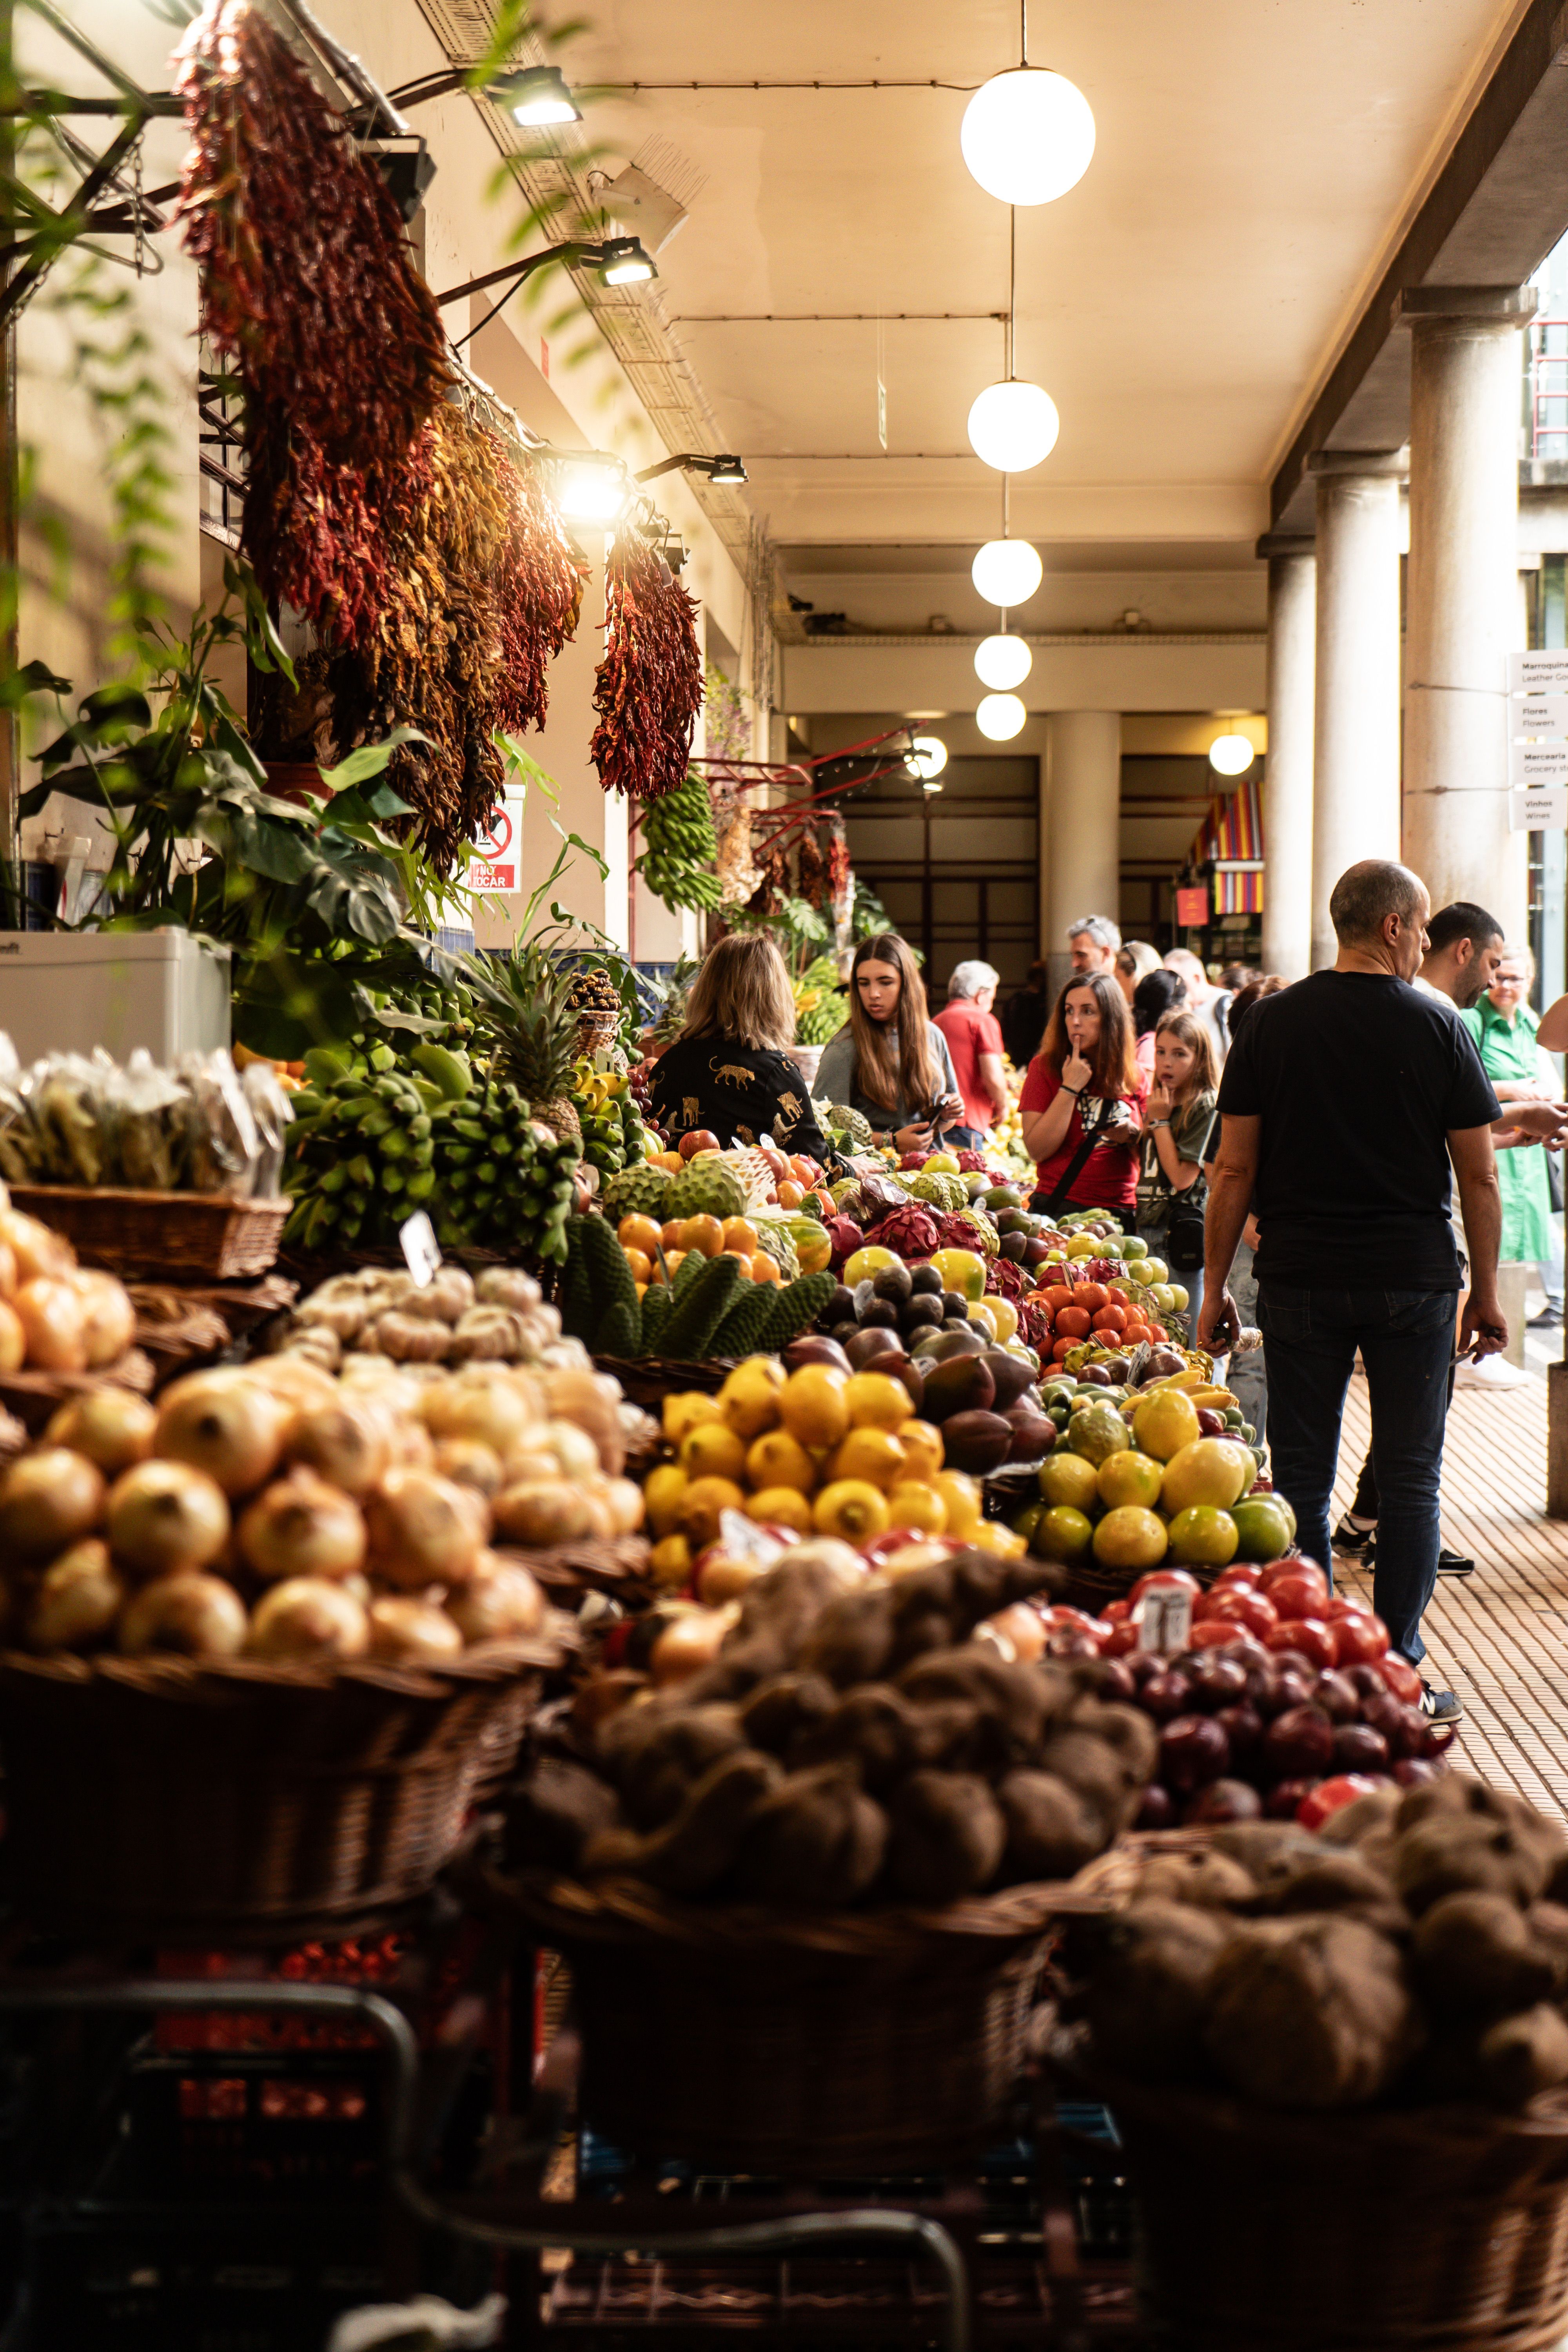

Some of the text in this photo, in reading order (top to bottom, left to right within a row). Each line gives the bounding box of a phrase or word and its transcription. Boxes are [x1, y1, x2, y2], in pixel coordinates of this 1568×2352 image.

[1523, 673, 1568, 682] Leather Go
[1524, 766, 1556, 774] Grocery
[473, 876, 506, 887] TOCAR
